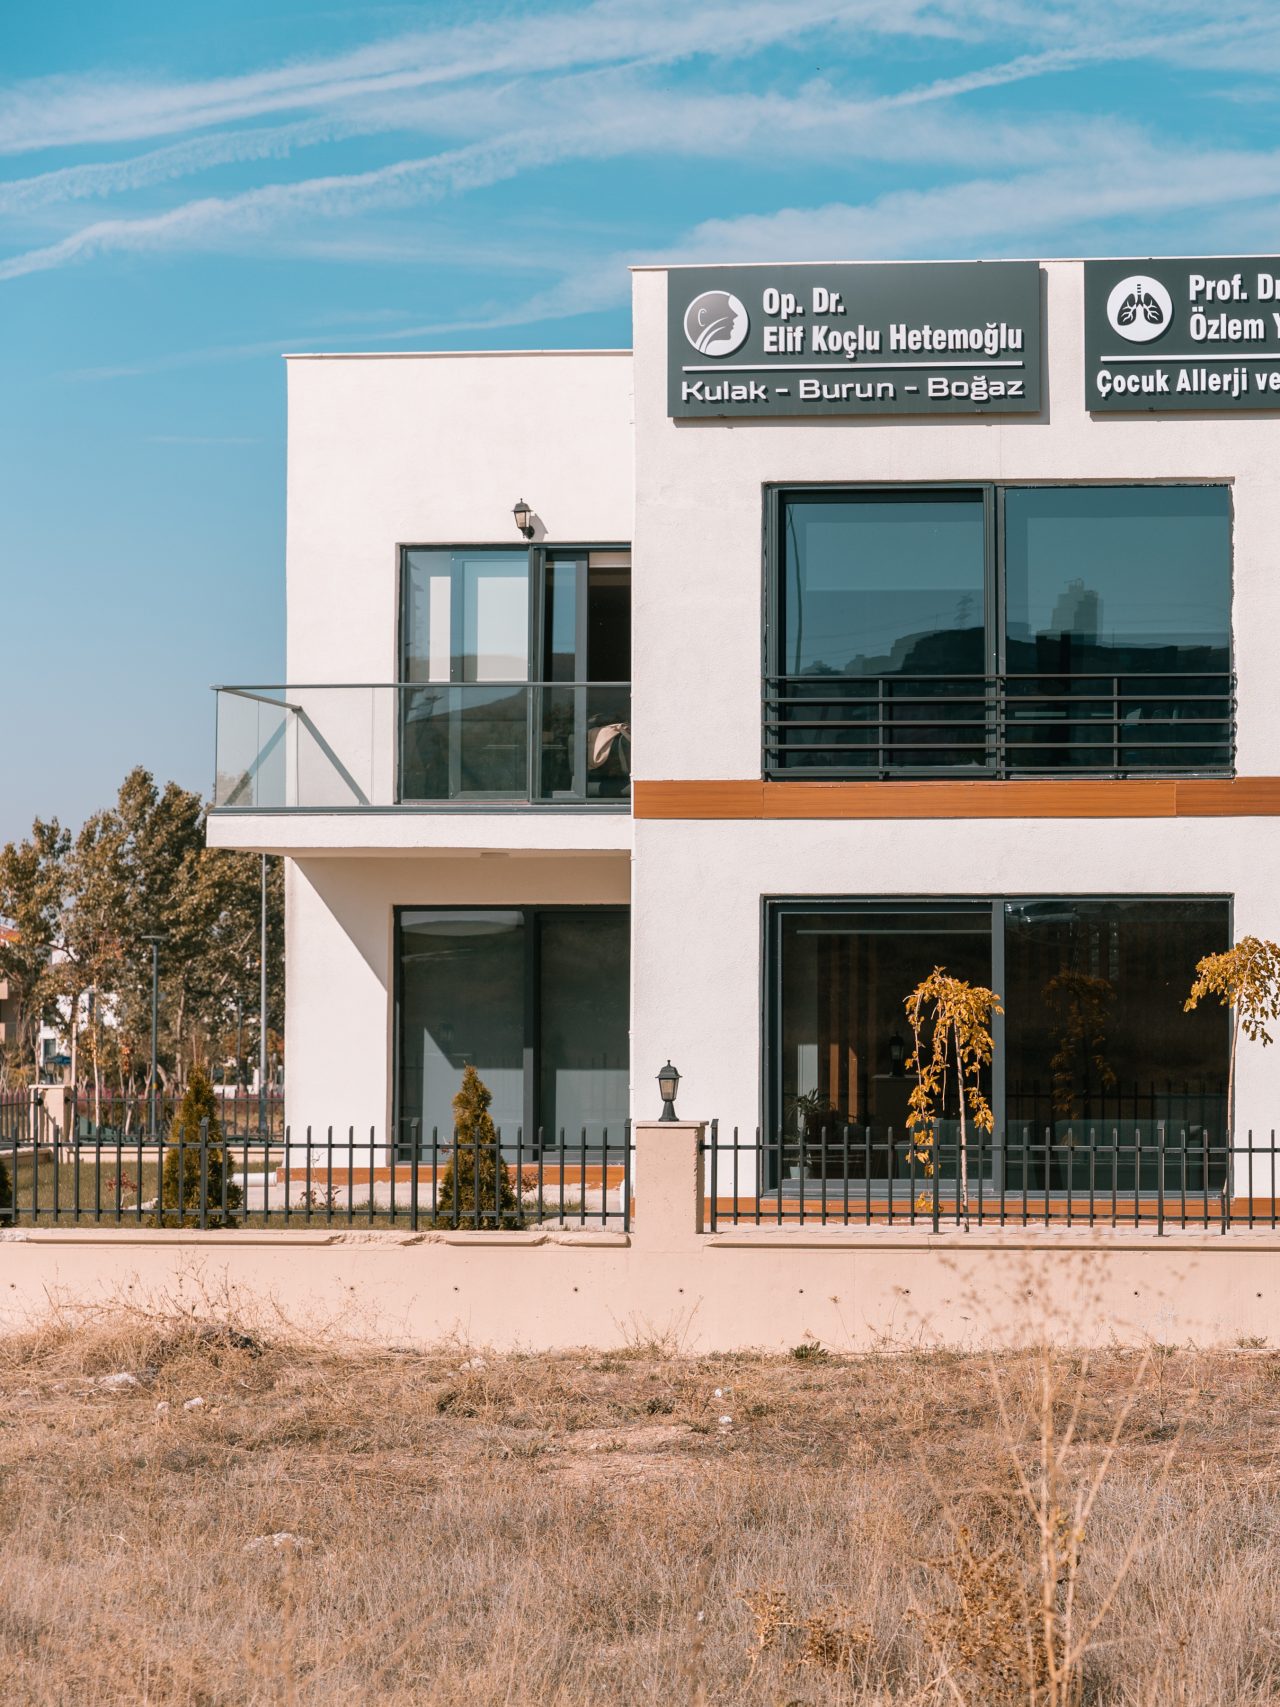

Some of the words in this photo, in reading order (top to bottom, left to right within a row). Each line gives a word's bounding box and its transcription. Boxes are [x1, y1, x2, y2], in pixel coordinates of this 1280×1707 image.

[762, 287, 804, 320] Op.
[812, 287, 846, 314] Dr.
[1189, 274, 1248, 301] Prof.
[1190, 306, 1265, 341] Özlem
[762, 325, 804, 353] Elif
[811, 324, 880, 359] Koçlu
[889, 322, 1023, 355] Hetemoğlu
[681, 380, 767, 402] Kulak
[799, 379, 894, 400] Burun
[927, 375, 1024, 401] Boğaz
[1096, 369, 1170, 399] Çocuk
[1176, 367, 1248, 397] Allerji
